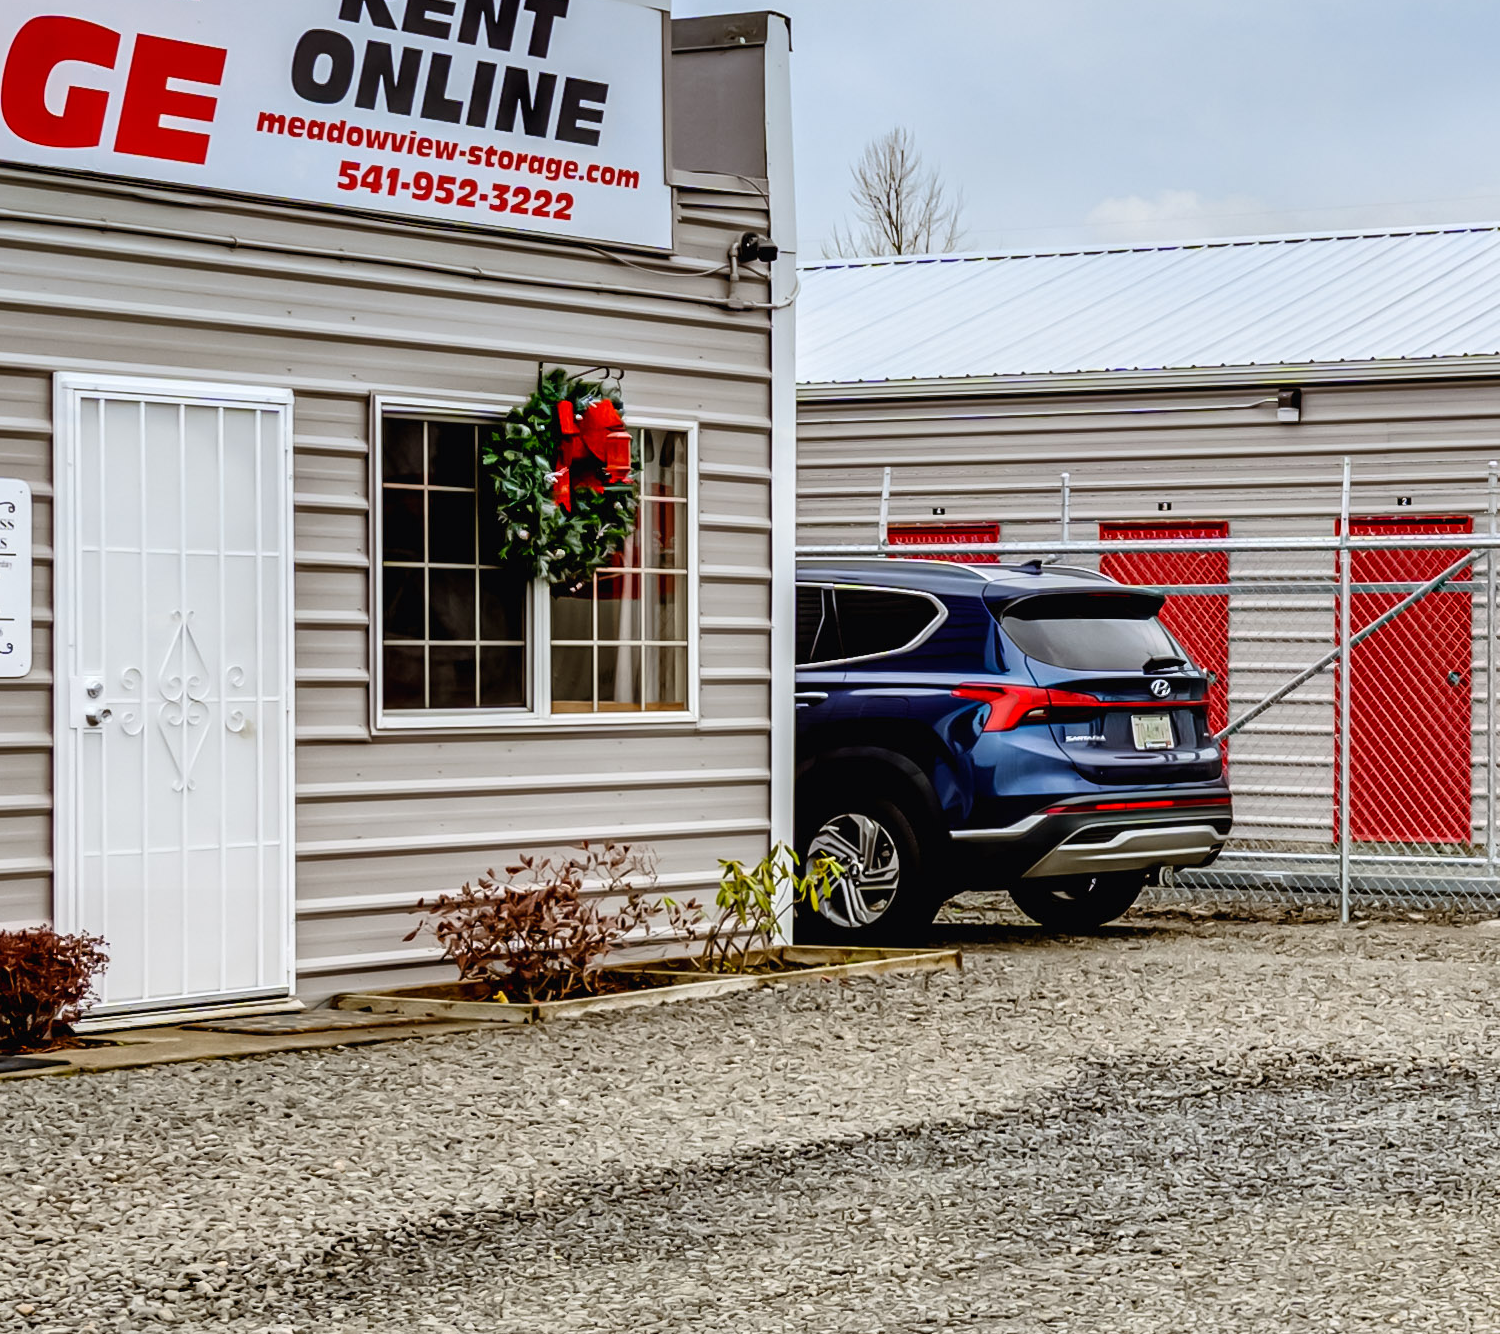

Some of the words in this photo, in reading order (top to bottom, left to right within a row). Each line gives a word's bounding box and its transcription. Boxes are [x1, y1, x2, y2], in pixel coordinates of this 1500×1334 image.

[291, 28, 609, 146] ONLINE
[256, 112, 640, 189] meadowview-storage.com
[337, 160, 575, 220] 541-952-3222
